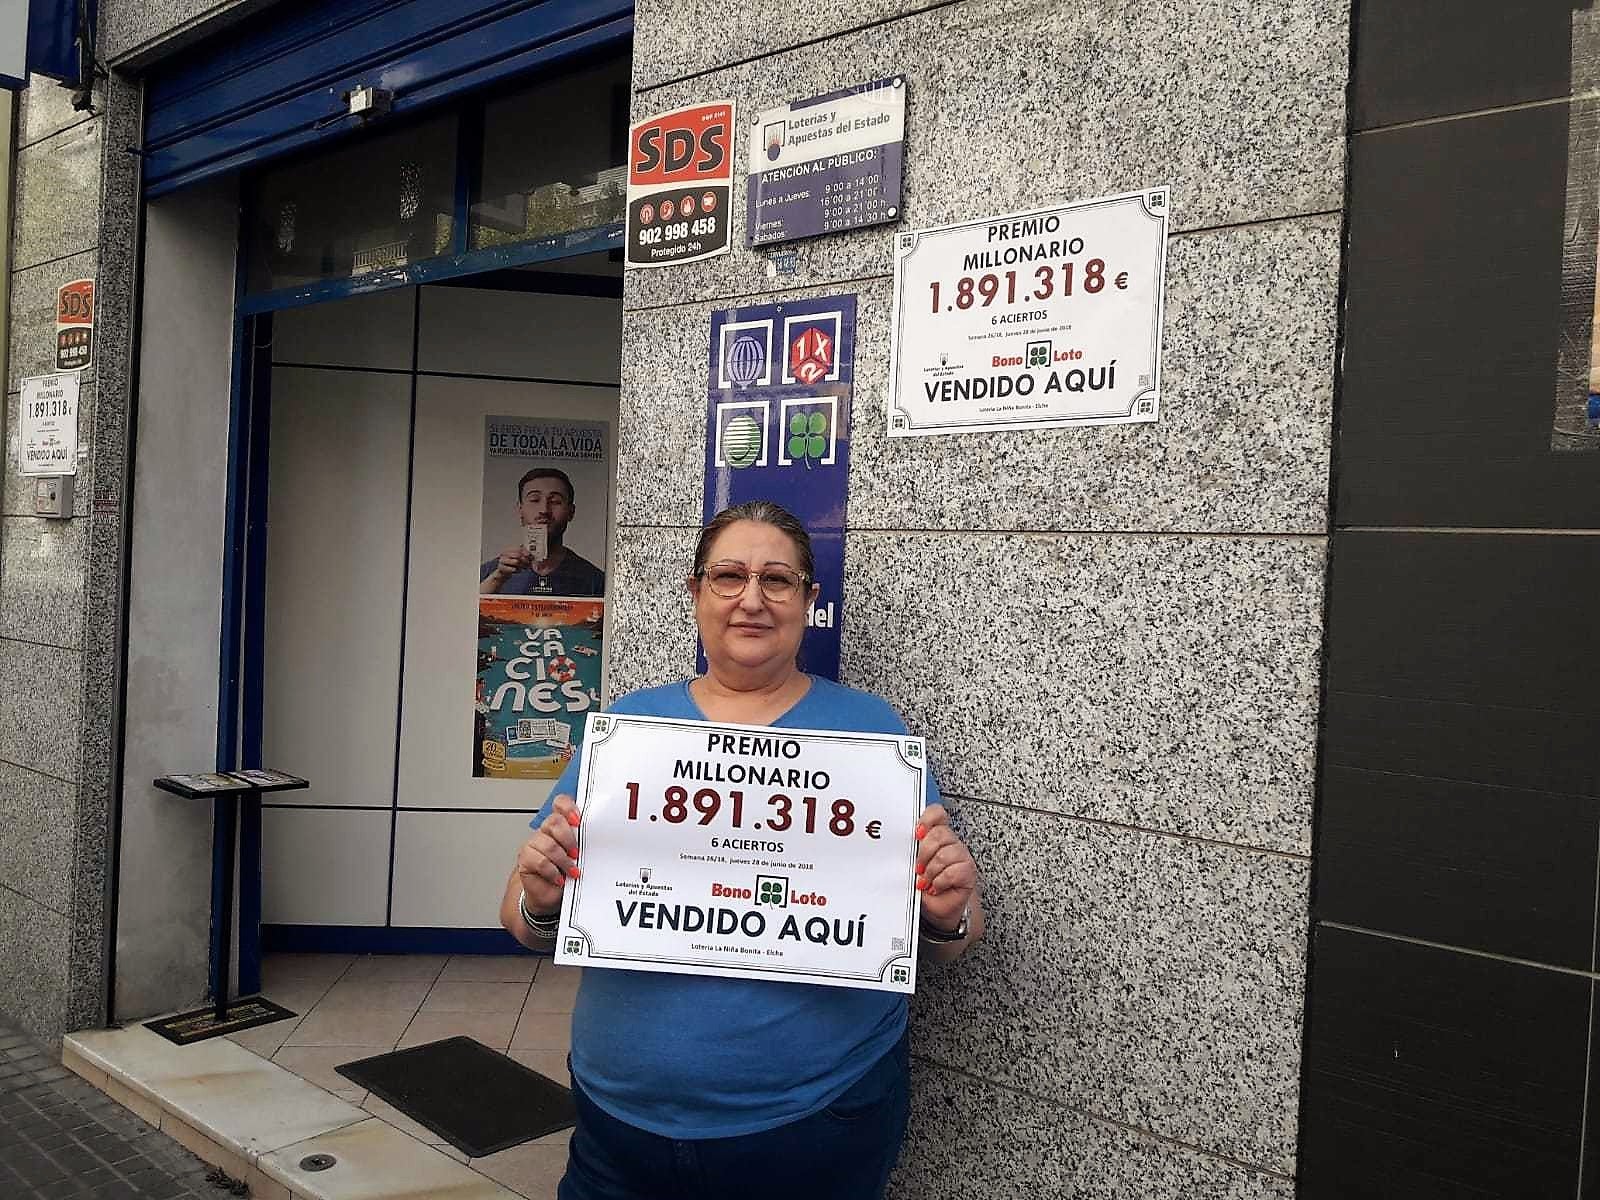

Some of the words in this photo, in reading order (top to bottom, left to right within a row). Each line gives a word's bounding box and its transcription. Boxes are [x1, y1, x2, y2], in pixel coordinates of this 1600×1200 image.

[830, 111, 836, 122] y
[788, 127, 833, 147] Apuestas
[836, 121, 852, 135] del
[854, 113, 890, 130] Estado
[636, 123, 725, 174] SDS
[812, 160, 826, 173] AL
[639, 226, 662, 246] 902
[664, 222, 688, 241] 998
[691, 216, 716, 236] 458
[988, 216, 1060, 243] PREMIO
[651, 244, 686, 258] Protegido
[688, 240, 702, 252] 24h
[963, 237, 1084, 272] MILLONARIO
[930, 258, 1106, 314] 1.891.318
[1114, 272, 1129, 290] €
[991, 316, 998, 326] 6
[1000, 310, 1048, 325] ACIERTOS
[814, 333, 829, 360] X
[992, 354, 1024, 368] Bono
[1054, 348, 1082, 362] Loto
[924, 373, 1034, 403] VENDIDO
[1044, 359, 1117, 394] AQUÍ
[490, 433, 510, 447] DE
[512, 434, 547, 450] TODA
[550, 436, 568, 451] LA
[570, 438, 602, 452] VIDA
[524, 628, 562, 640] VA
[520, 641, 565, 657] CA
[505, 656, 576, 682] CIO
[707, 732, 801, 759] PREMIO
[673, 760, 830, 790] MILLONARIO
[625, 782, 855, 837] 1.891.318
[865, 820, 882, 839] €
[711, 838, 719, 848] 6
[722, 838, 784, 853] ACIERTOS
[680, 852, 704, 861] Semana
[730, 856, 750, 865] jueves
[770, 860, 786, 868] junio
[712, 883, 752, 900] Bono
[790, 890, 827, 906] Loto
[616, 900, 766, 937] VENDIDO
[778, 914, 868, 948] AQUÍ
[715, 944, 722, 952] La
[740, 947, 761, 955] Bonita
